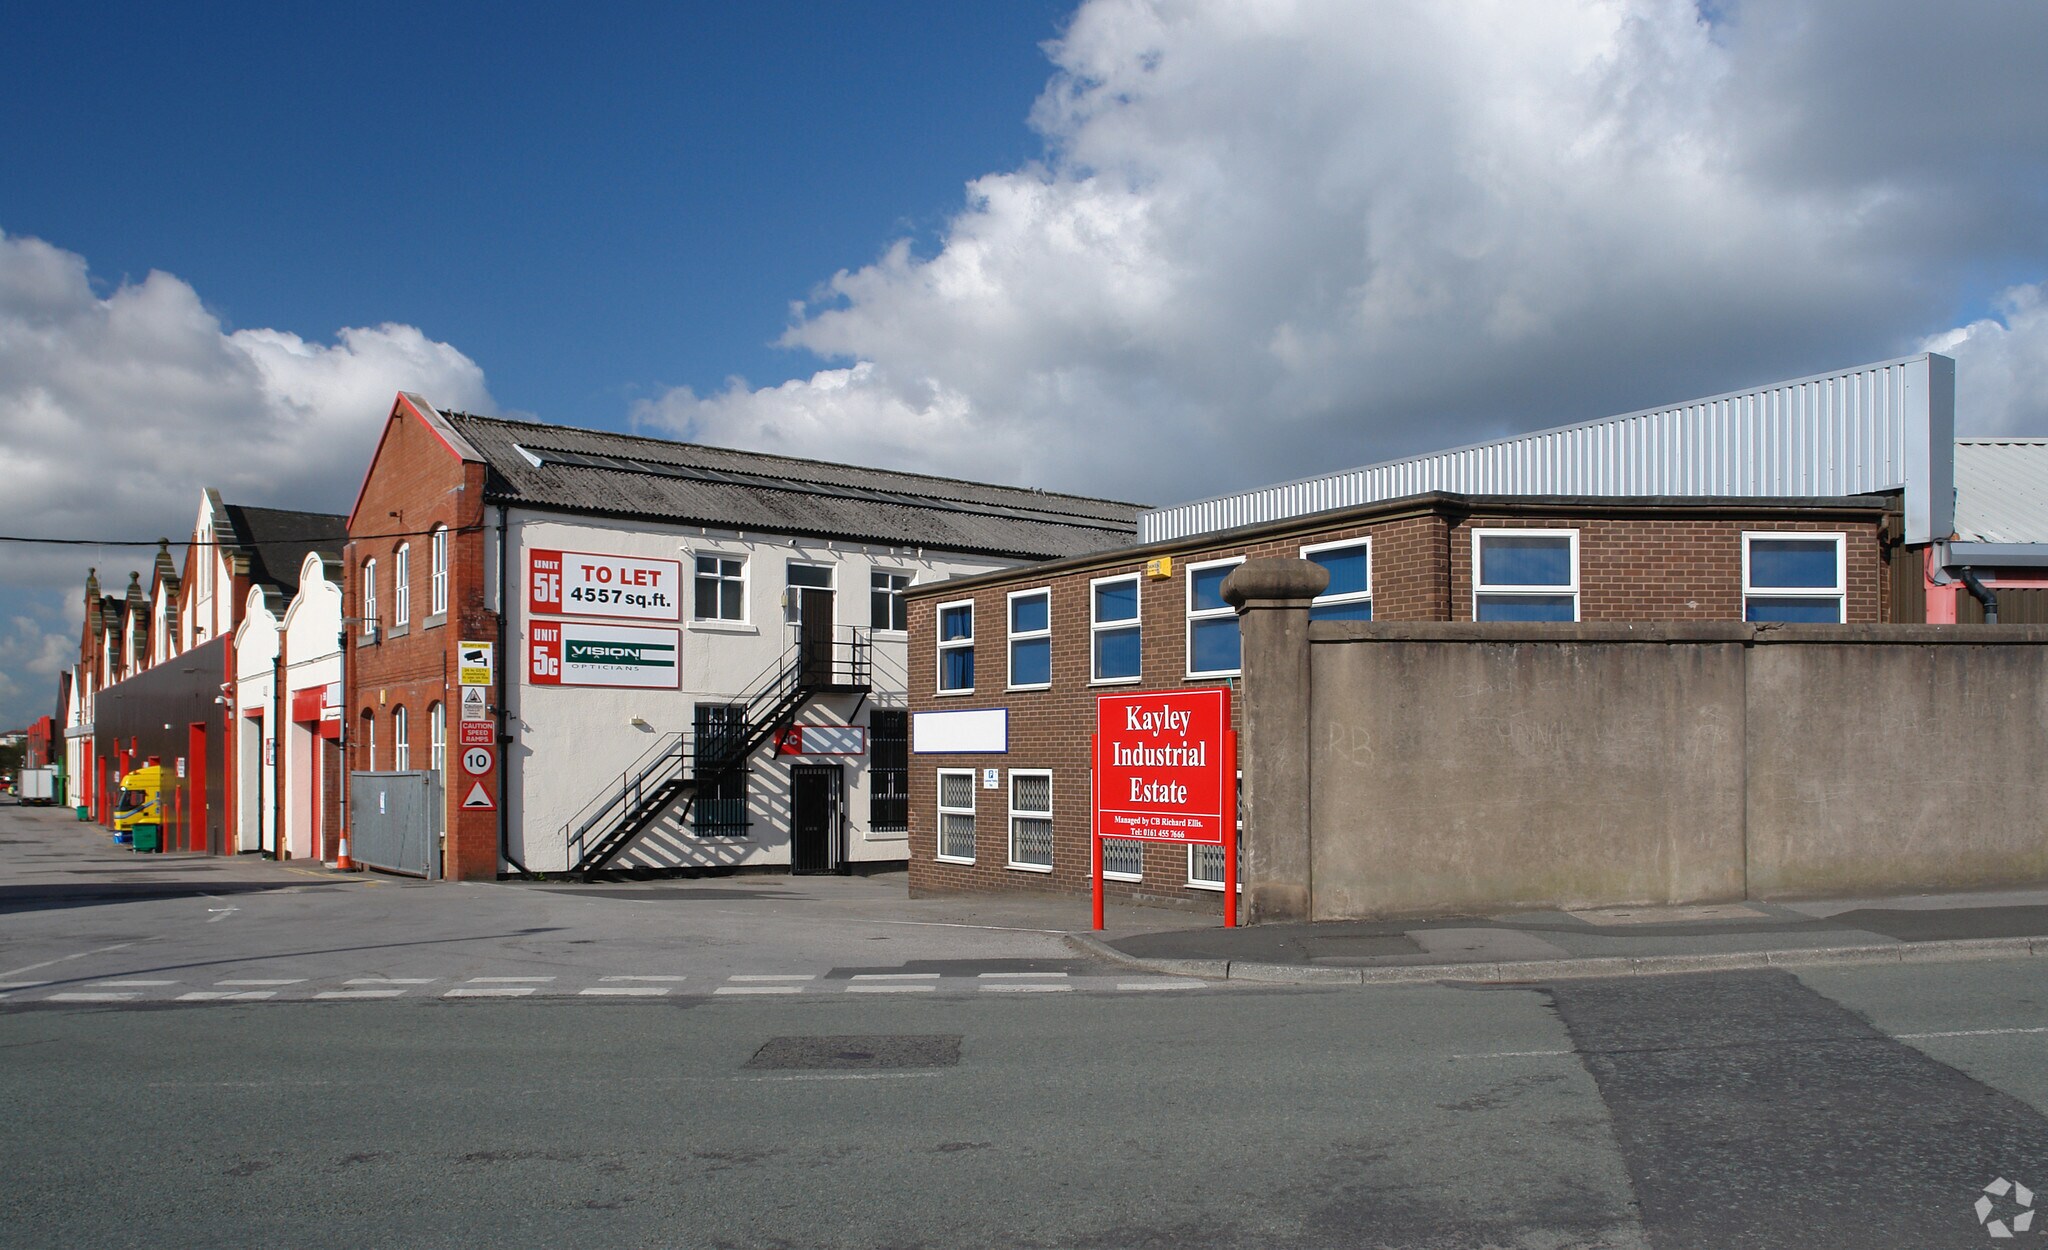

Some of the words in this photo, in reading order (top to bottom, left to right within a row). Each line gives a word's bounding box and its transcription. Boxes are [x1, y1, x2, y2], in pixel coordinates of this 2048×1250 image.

[534, 560, 559, 570] UNIT
[581, 565, 612, 584] TO
[620, 568, 661, 587] LET
[533, 573, 559, 603] 5E
[571, 587, 622, 604] 4557
[625, 593, 671, 608] sq.ft.
[534, 628, 558, 642] UNIT
[571, 646, 639, 657] VISION
[1125, 704, 1191, 737] Kayley
[467, 754, 487, 768] 10
[1112, 740, 1206, 767] Industrial
[1129, 777, 1187, 804] Estate
[1114, 815, 1141, 826] Managed
[1141, 817, 1149, 826] by
[1161, 818, 1186, 827] Richard
[1130, 828, 1142, 836] Tel:
[1143, 829, 1157, 837] 0161
[1170, 830, 1185, 838] 7666
